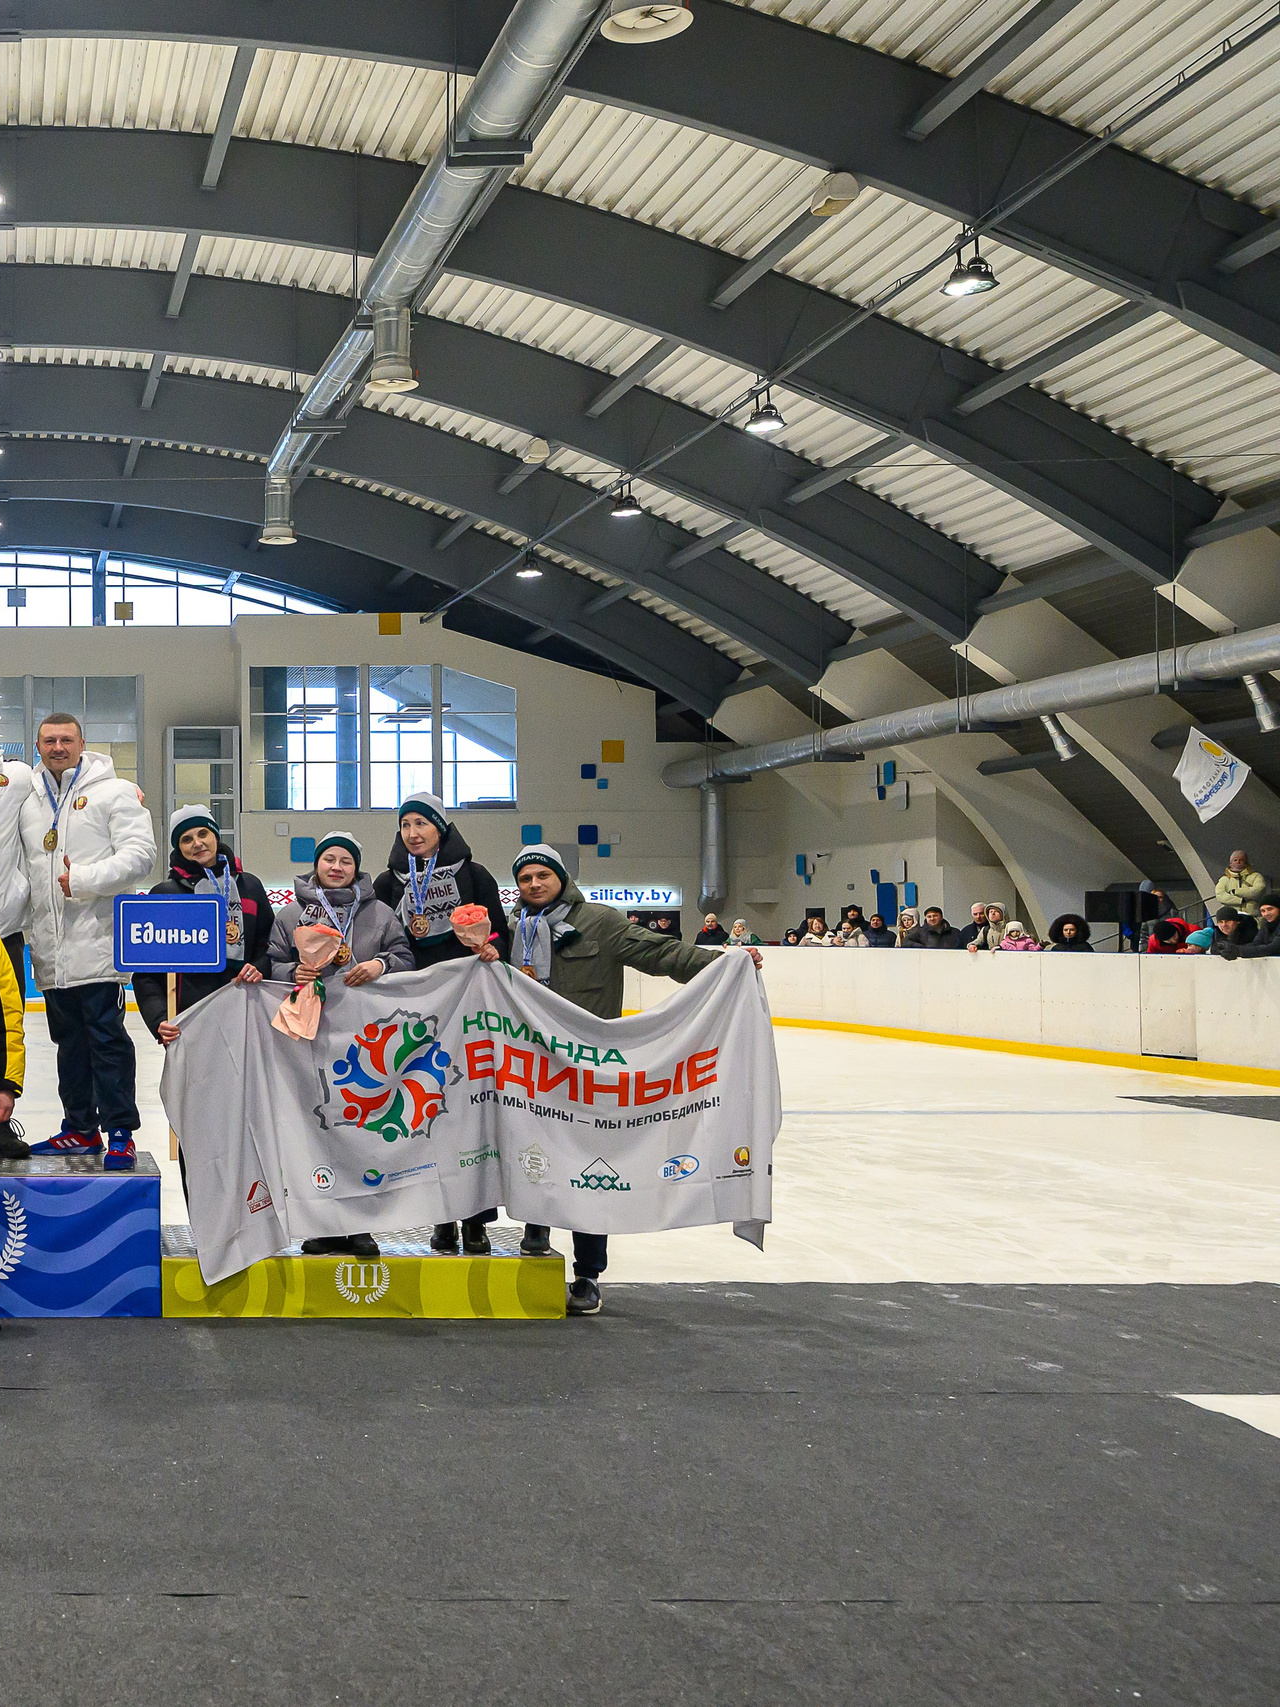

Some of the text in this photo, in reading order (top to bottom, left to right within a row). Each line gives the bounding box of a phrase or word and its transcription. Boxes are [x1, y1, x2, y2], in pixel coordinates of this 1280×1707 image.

[409, 884, 454, 903] ЕИНЫЕ
[590, 889, 672, 903] silichy.by
[305, 905, 344, 922] ЕДИНЕ
[130, 922, 209, 944] Единые
[463, 1010, 627, 1066] КОМАНДА
[465, 1039, 719, 1108] ЕДИНЫЕ
[503, 1095, 527, 1110] МЫ
[529, 1102, 574, 1123] ЕДИНЫ
[594, 1119, 622, 1129] МЫ
[626, 1096, 721, 1129] НЕПОБЕДИМЫ!
[346, 1264, 380, 1289] III
